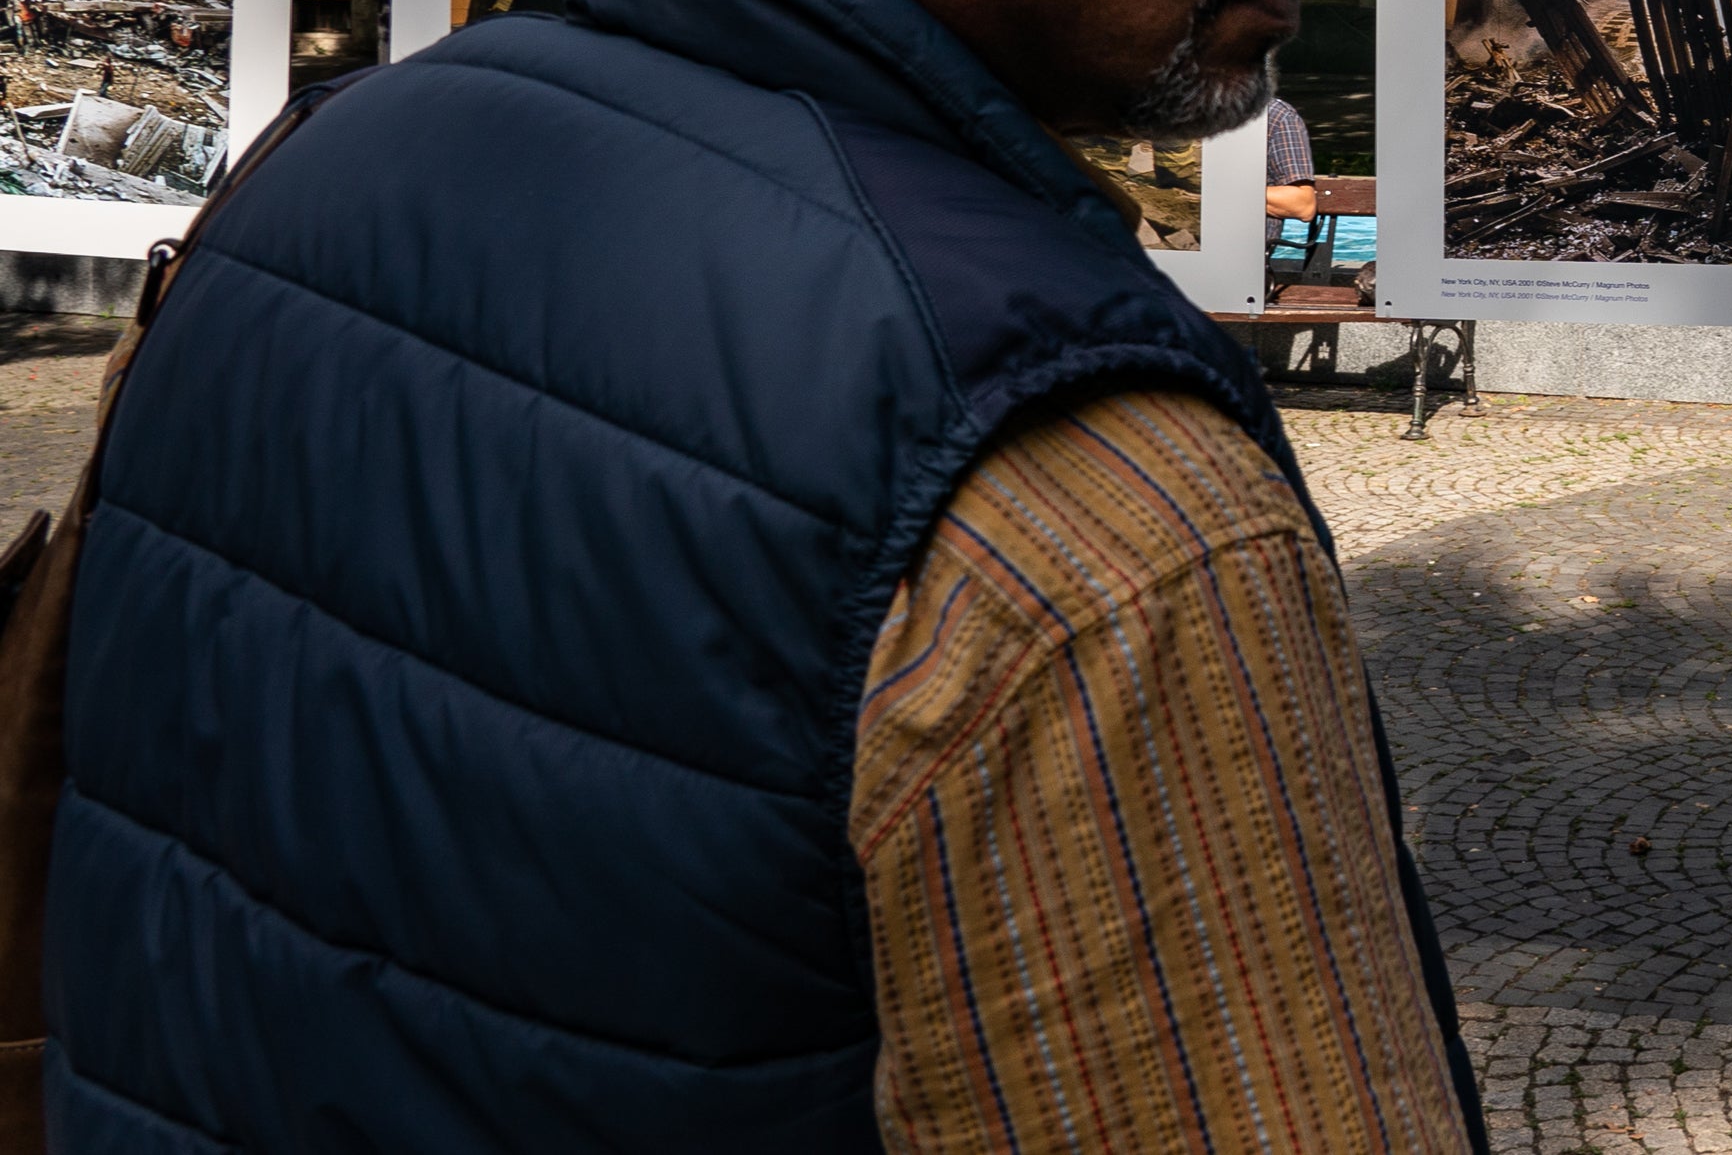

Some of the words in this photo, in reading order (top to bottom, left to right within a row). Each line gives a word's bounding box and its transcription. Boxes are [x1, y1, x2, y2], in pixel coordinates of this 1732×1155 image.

[1502, 279, 1517, 287] USA
[1562, 281, 1589, 289] McCurry
[1626, 282, 1650, 290] Photos
[1441, 290, 1456, 298] New
[1561, 293, 1588, 302] McCurry
[1595, 294, 1624, 303] Magnum
[1625, 294, 1649, 302] Photos
